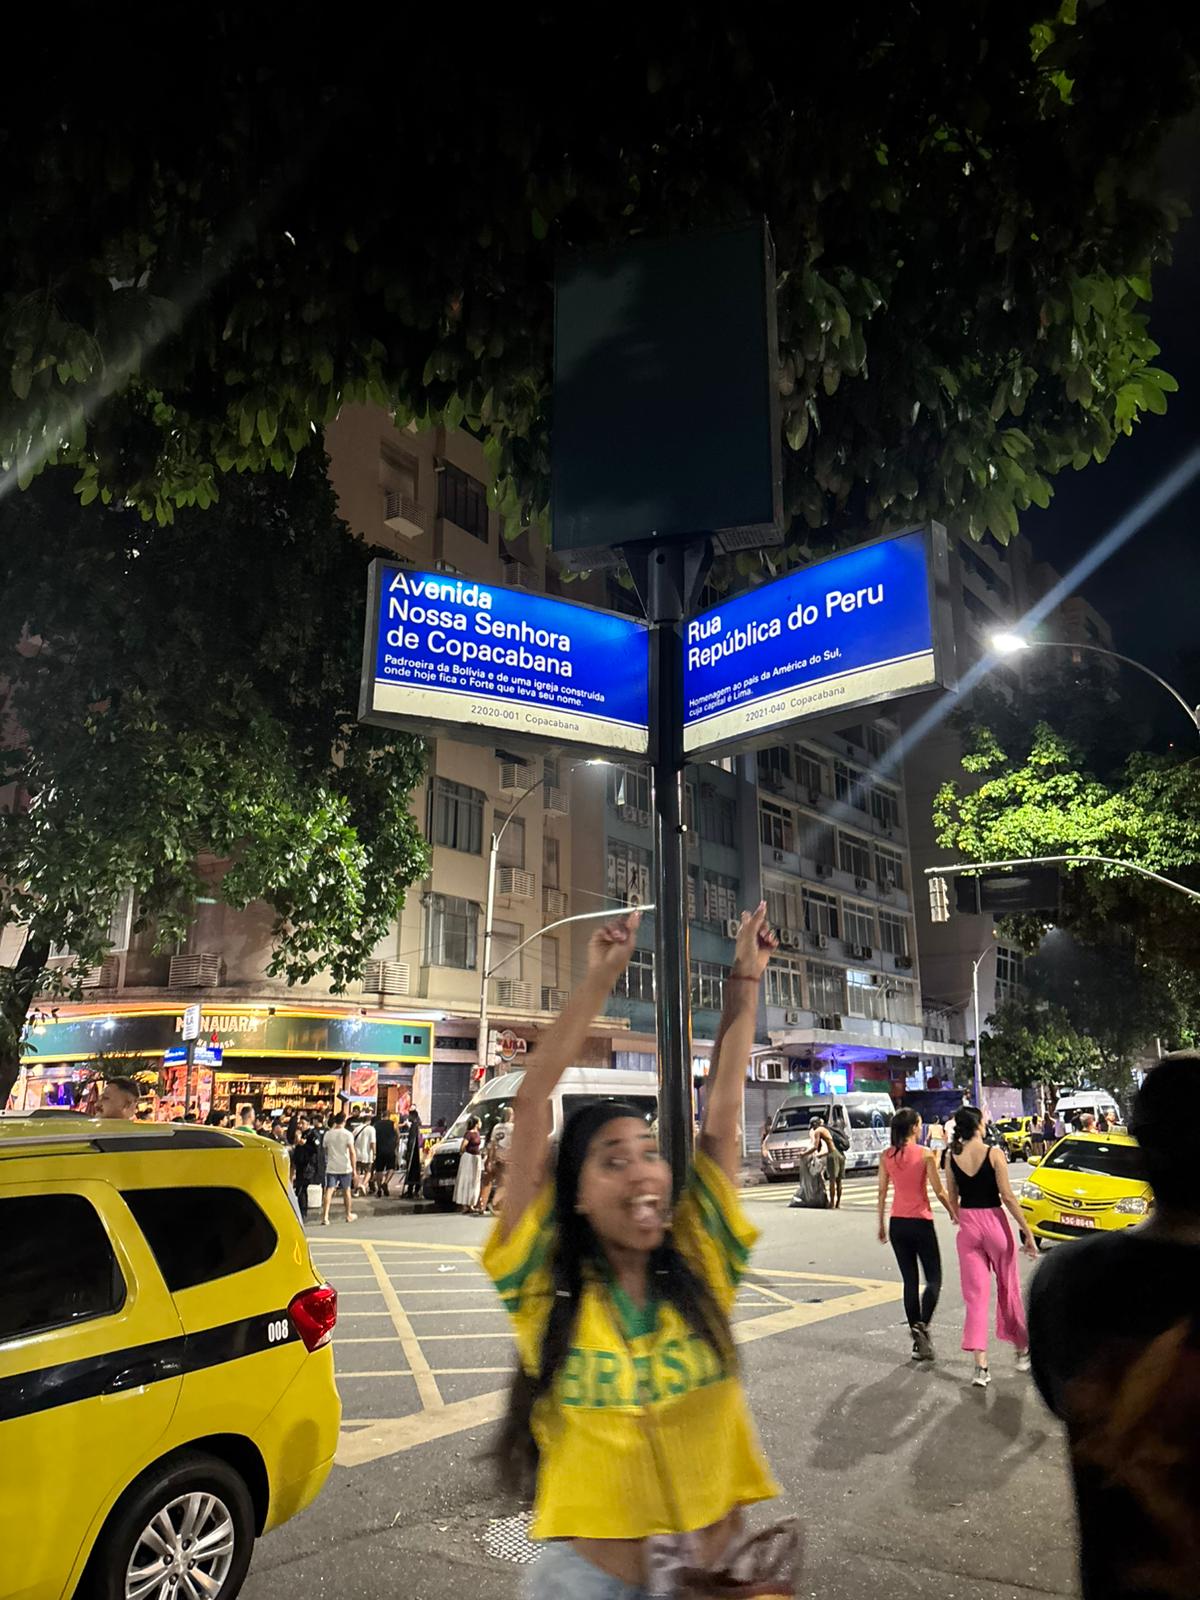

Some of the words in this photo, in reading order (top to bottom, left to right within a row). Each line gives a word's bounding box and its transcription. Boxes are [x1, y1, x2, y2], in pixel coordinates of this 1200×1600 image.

[388, 572, 492, 610] Avenida
[388, 597, 467, 631] Nossa
[474, 611, 571, 652] Senhora
[688, 617, 781, 671] República
[787, 603, 818, 631] do
[825, 583, 884, 618] Peru
[688, 615, 721, 645] Rua
[386, 625, 419, 650] de
[427, 630, 573, 678] Copacabana
[384, 654, 434, 671] Padroeira
[437, 663, 450, 673] da
[452, 664, 485, 679] Bolívia
[487, 672, 494, 680] e
[496, 673, 509, 683] de
[511, 676, 532, 687] uma
[534, 679, 559, 693] igreja
[384, 666, 411, 677] onde
[414, 669, 436, 682] hoje
[439, 673, 457, 684] fica
[469, 678, 494, 690] Forte
[496, 683, 515, 693] que
[517, 686, 536, 697] leva
[538, 691, 555, 700] seu
[556, 694, 584, 707] nome.
[689, 686, 732, 708] Homenagem
[732, 682, 743, 691] ao
[760, 671, 771, 681] da
[772, 659, 807, 677] América
[809, 654, 822, 665] do
[470, 704, 520, 721] 22020-001
[525, 713, 580, 731] Copacabana
[689, 706, 703, 717] cuja
[703, 695, 726, 711] capital
[745, 702, 786, 723] 22021-040
[790, 686, 846, 708] Copacabana
[175, 1016, 258, 1033] MNAUARA
[268, 1319, 288, 1342] 008
